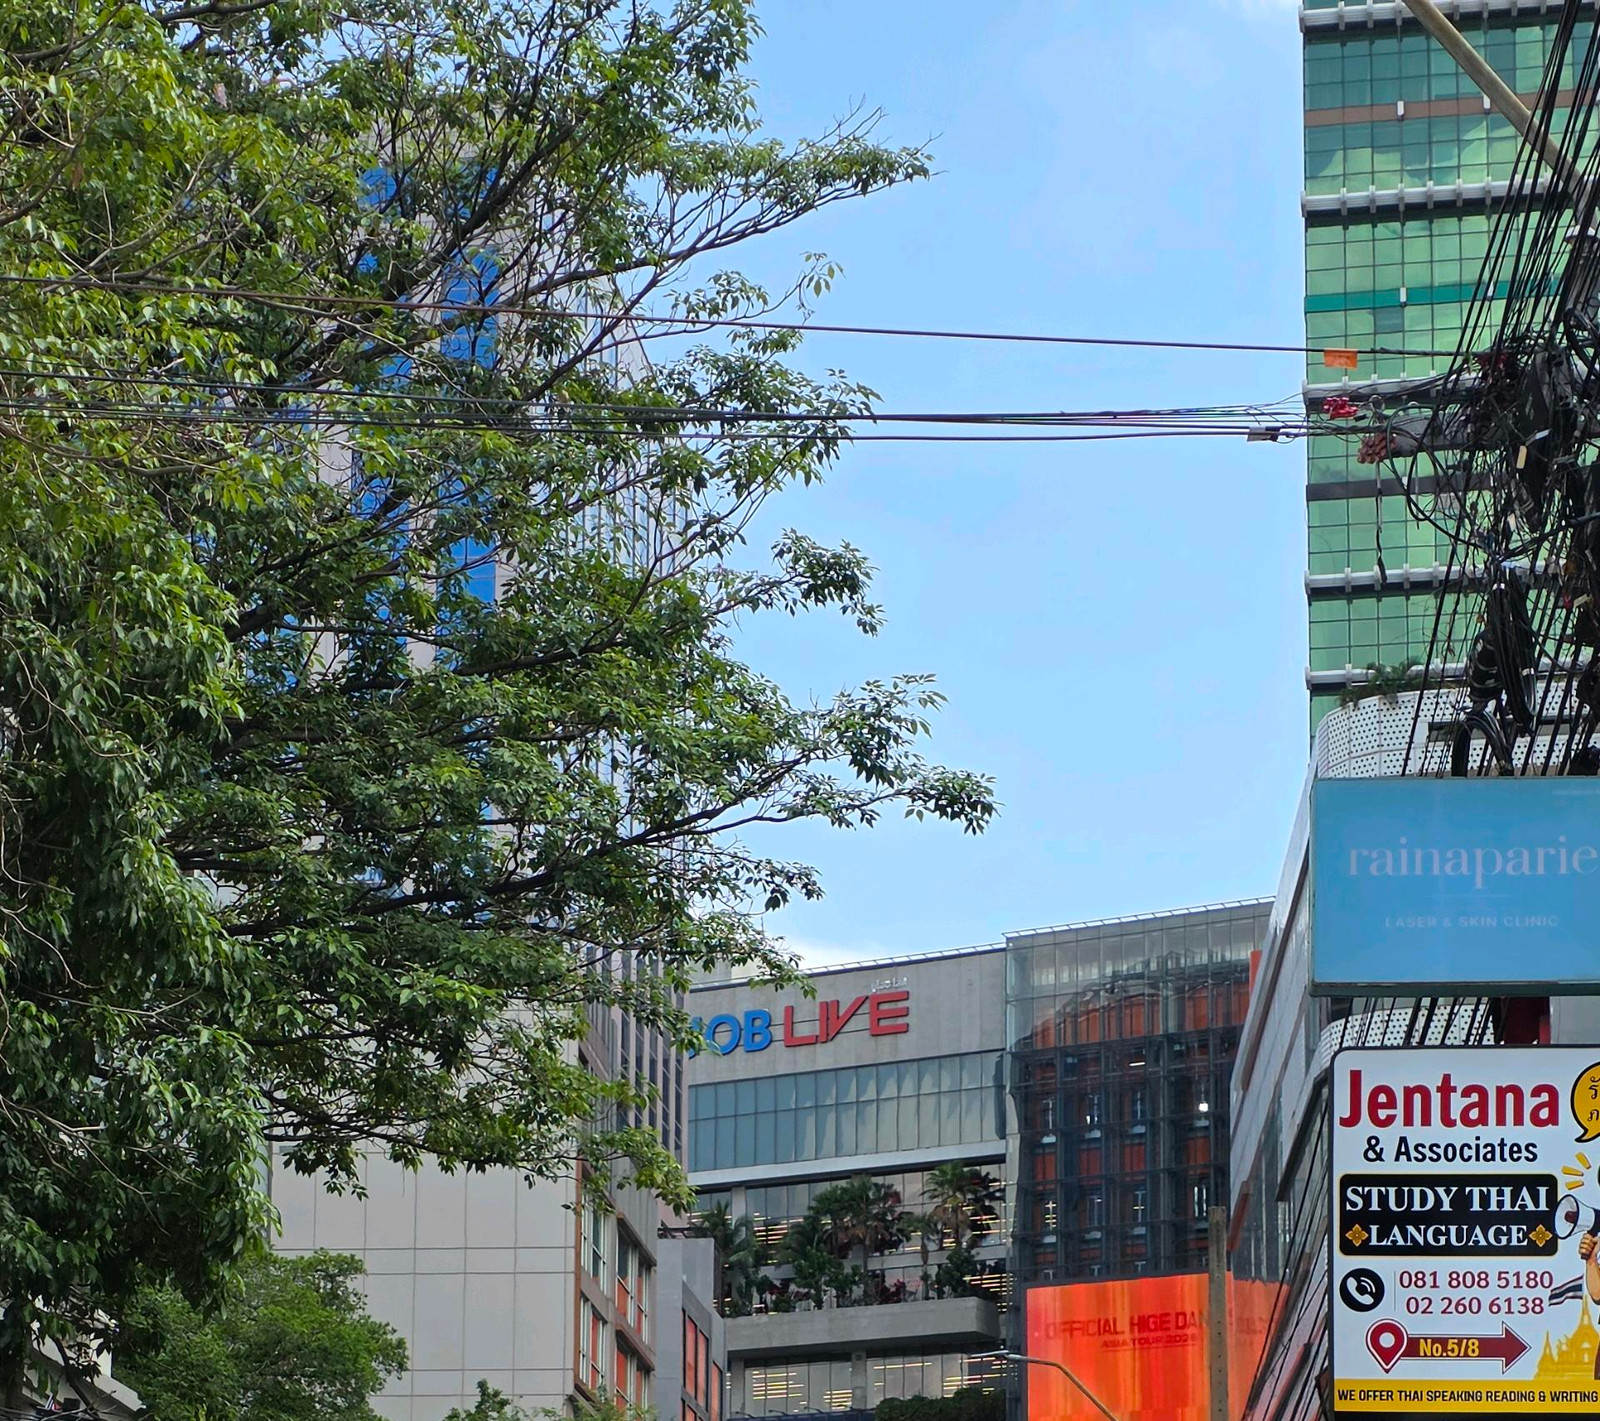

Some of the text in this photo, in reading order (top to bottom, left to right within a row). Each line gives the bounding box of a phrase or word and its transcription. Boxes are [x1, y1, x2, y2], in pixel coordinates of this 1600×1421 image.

[1349, 836, 1600, 889] rainaparie
[1385, 916, 1437, 928] LASER
[1458, 916, 1497, 927] SKIN
[1503, 915, 1559, 927] CLINIC
[783, 990, 910, 1047] LIVE
[1339, 1069, 1560, 1129] Jentana
[1363, 1135, 1538, 1163] & Associates
[1346, 1186, 1550, 1212] STUDY THAI
[1369, 1225, 1528, 1247] LANGUAGE
[1399, 1271, 1553, 1289] 081 808 5180
[1406, 1297, 1544, 1315] 02 260 6138
[1046, 1317, 1126, 1340] OFFICIAL
[1129, 1311, 1171, 1335] HIGE
[1131, 1336, 1163, 1347] TOUR
[1419, 1338, 1480, 1357] No.5/8
[1338, 1389, 1599, 1403] WE OFFER THAI SPEAKING READING & WRITING
